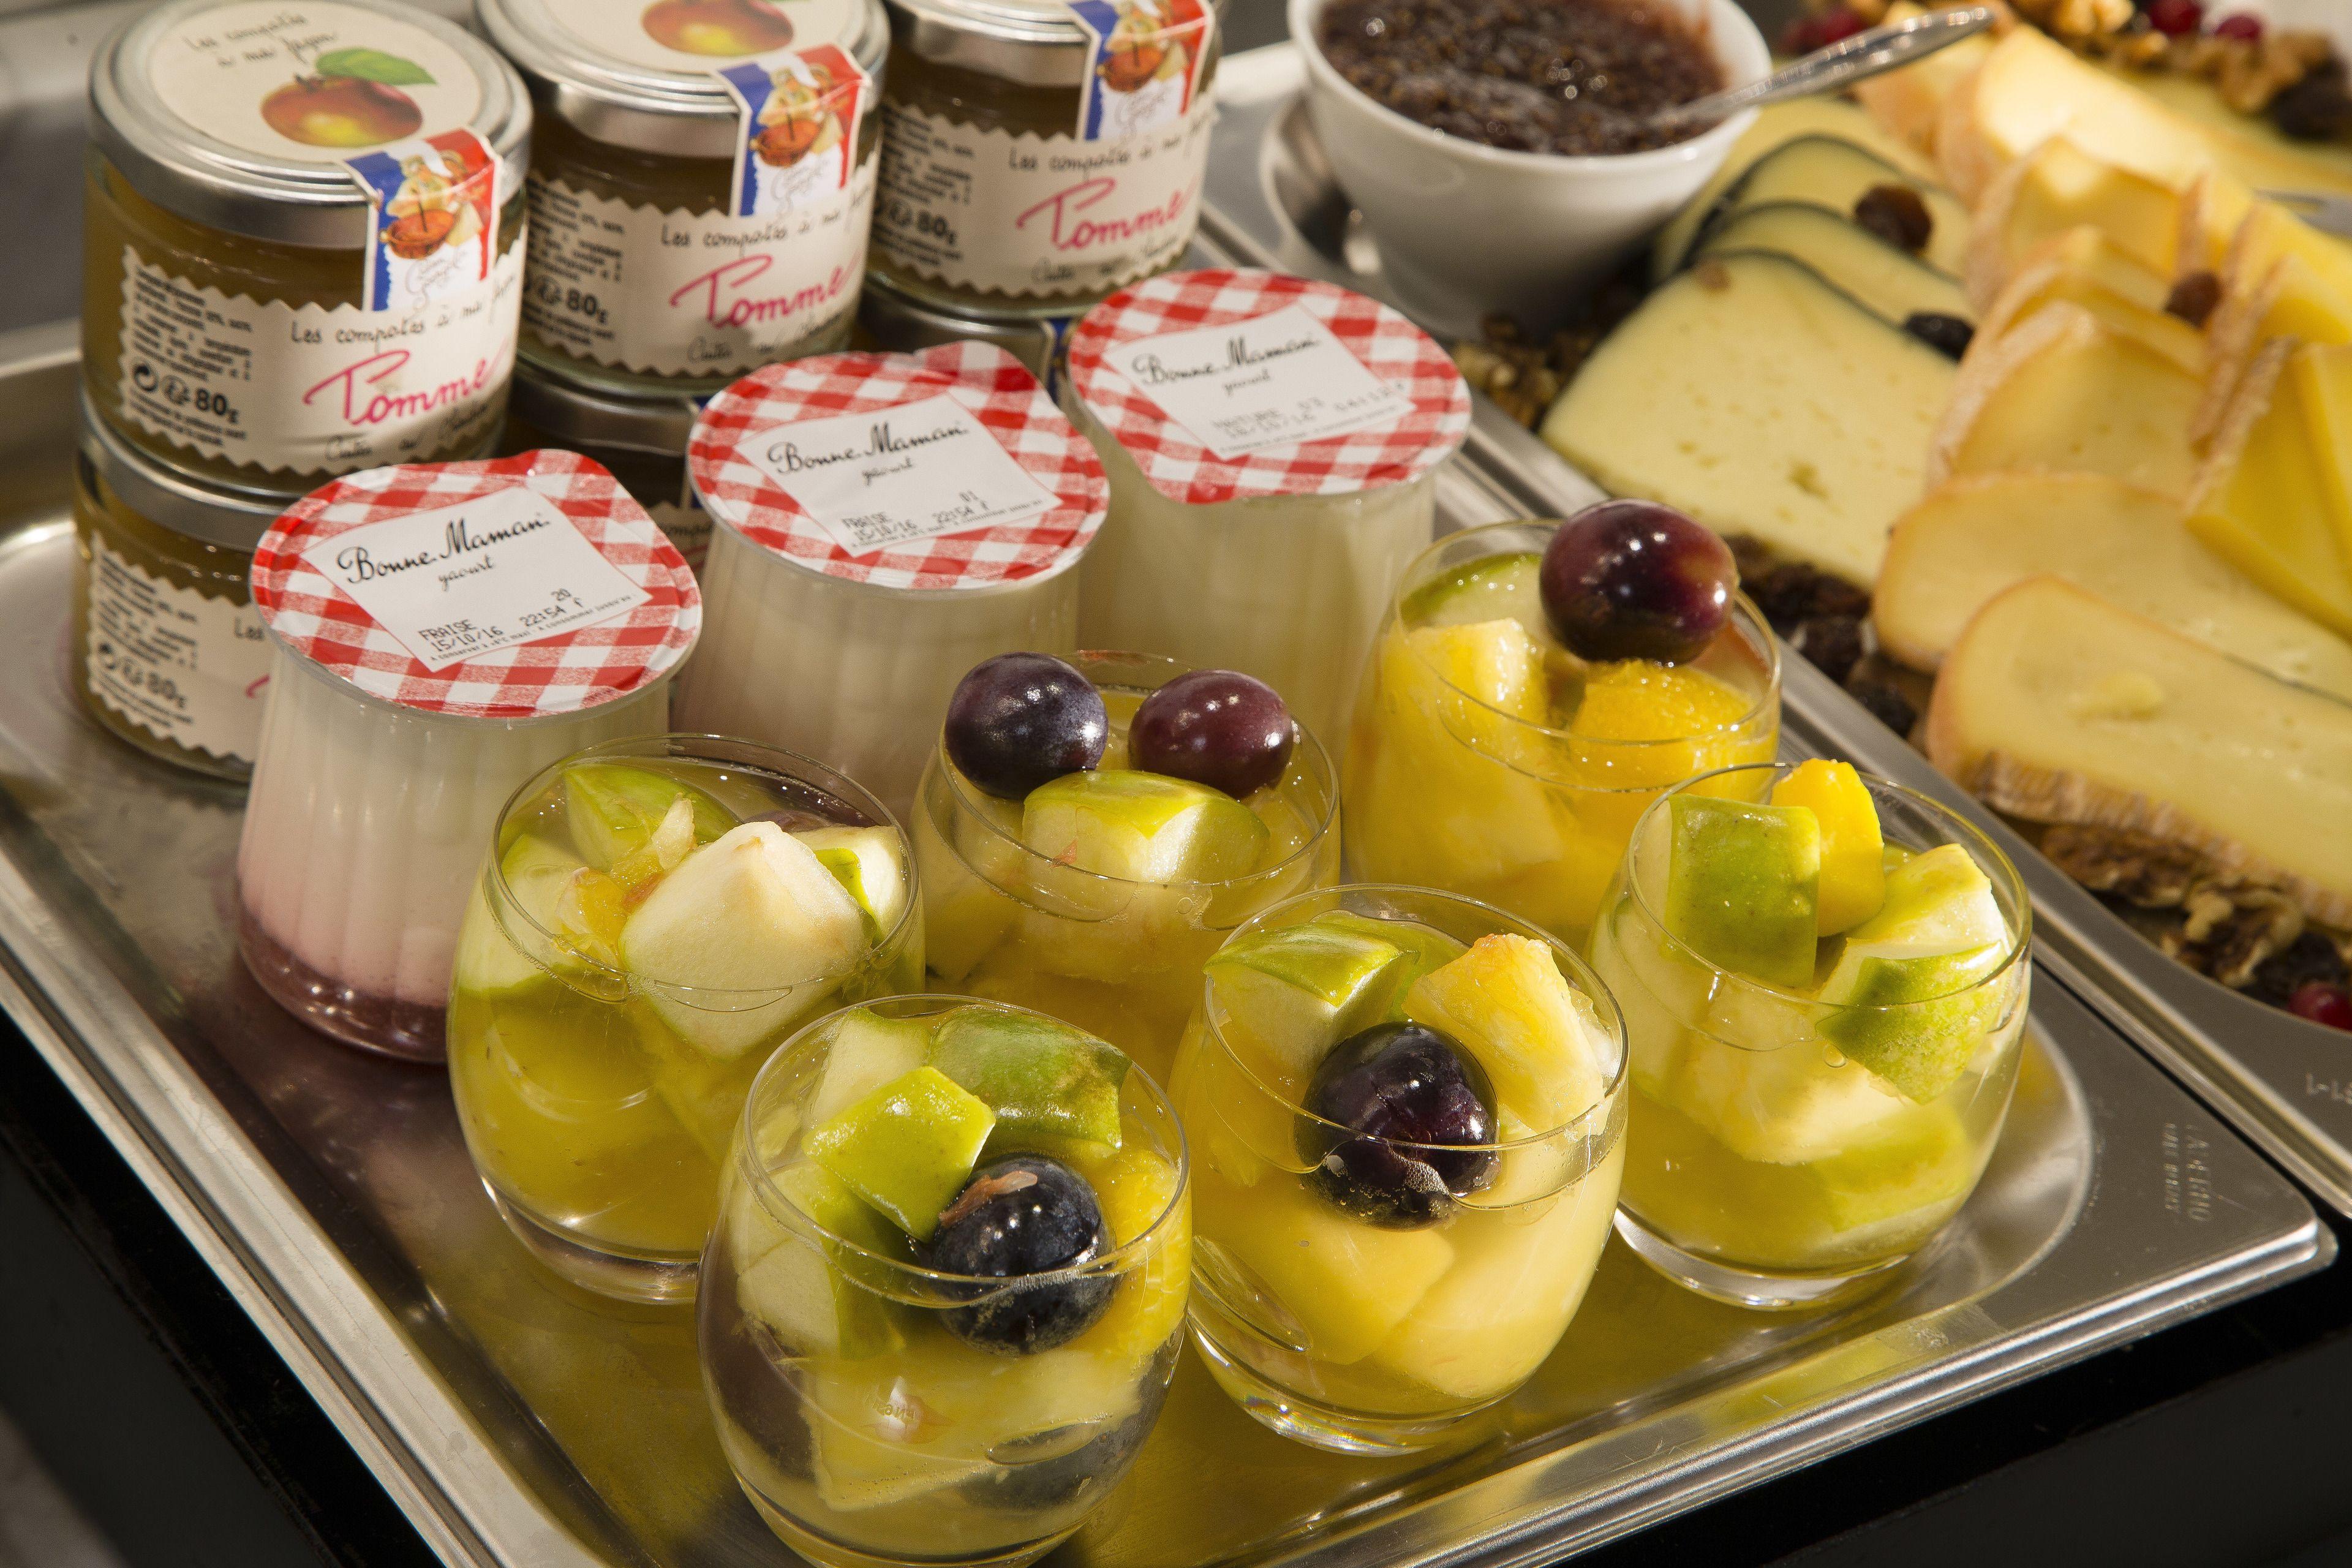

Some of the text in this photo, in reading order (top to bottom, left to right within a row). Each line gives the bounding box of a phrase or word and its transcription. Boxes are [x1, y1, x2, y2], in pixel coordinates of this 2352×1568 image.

[662, 222, 691, 247] Les
[669, 251, 861, 330] Pomme
[292, 320, 322, 343] Les
[302, 336, 508, 426] Pomme
[1131, 334, 1323, 385] Bonne Maman
[767, 421, 970, 475] Bonne Maman
[336, 517, 551, 585] Bonne Maman
[437, 553, 496, 594] yaourt
[418, 587, 571, 642] FRAISE 20
[431, 625, 504, 652] 15/10/16
